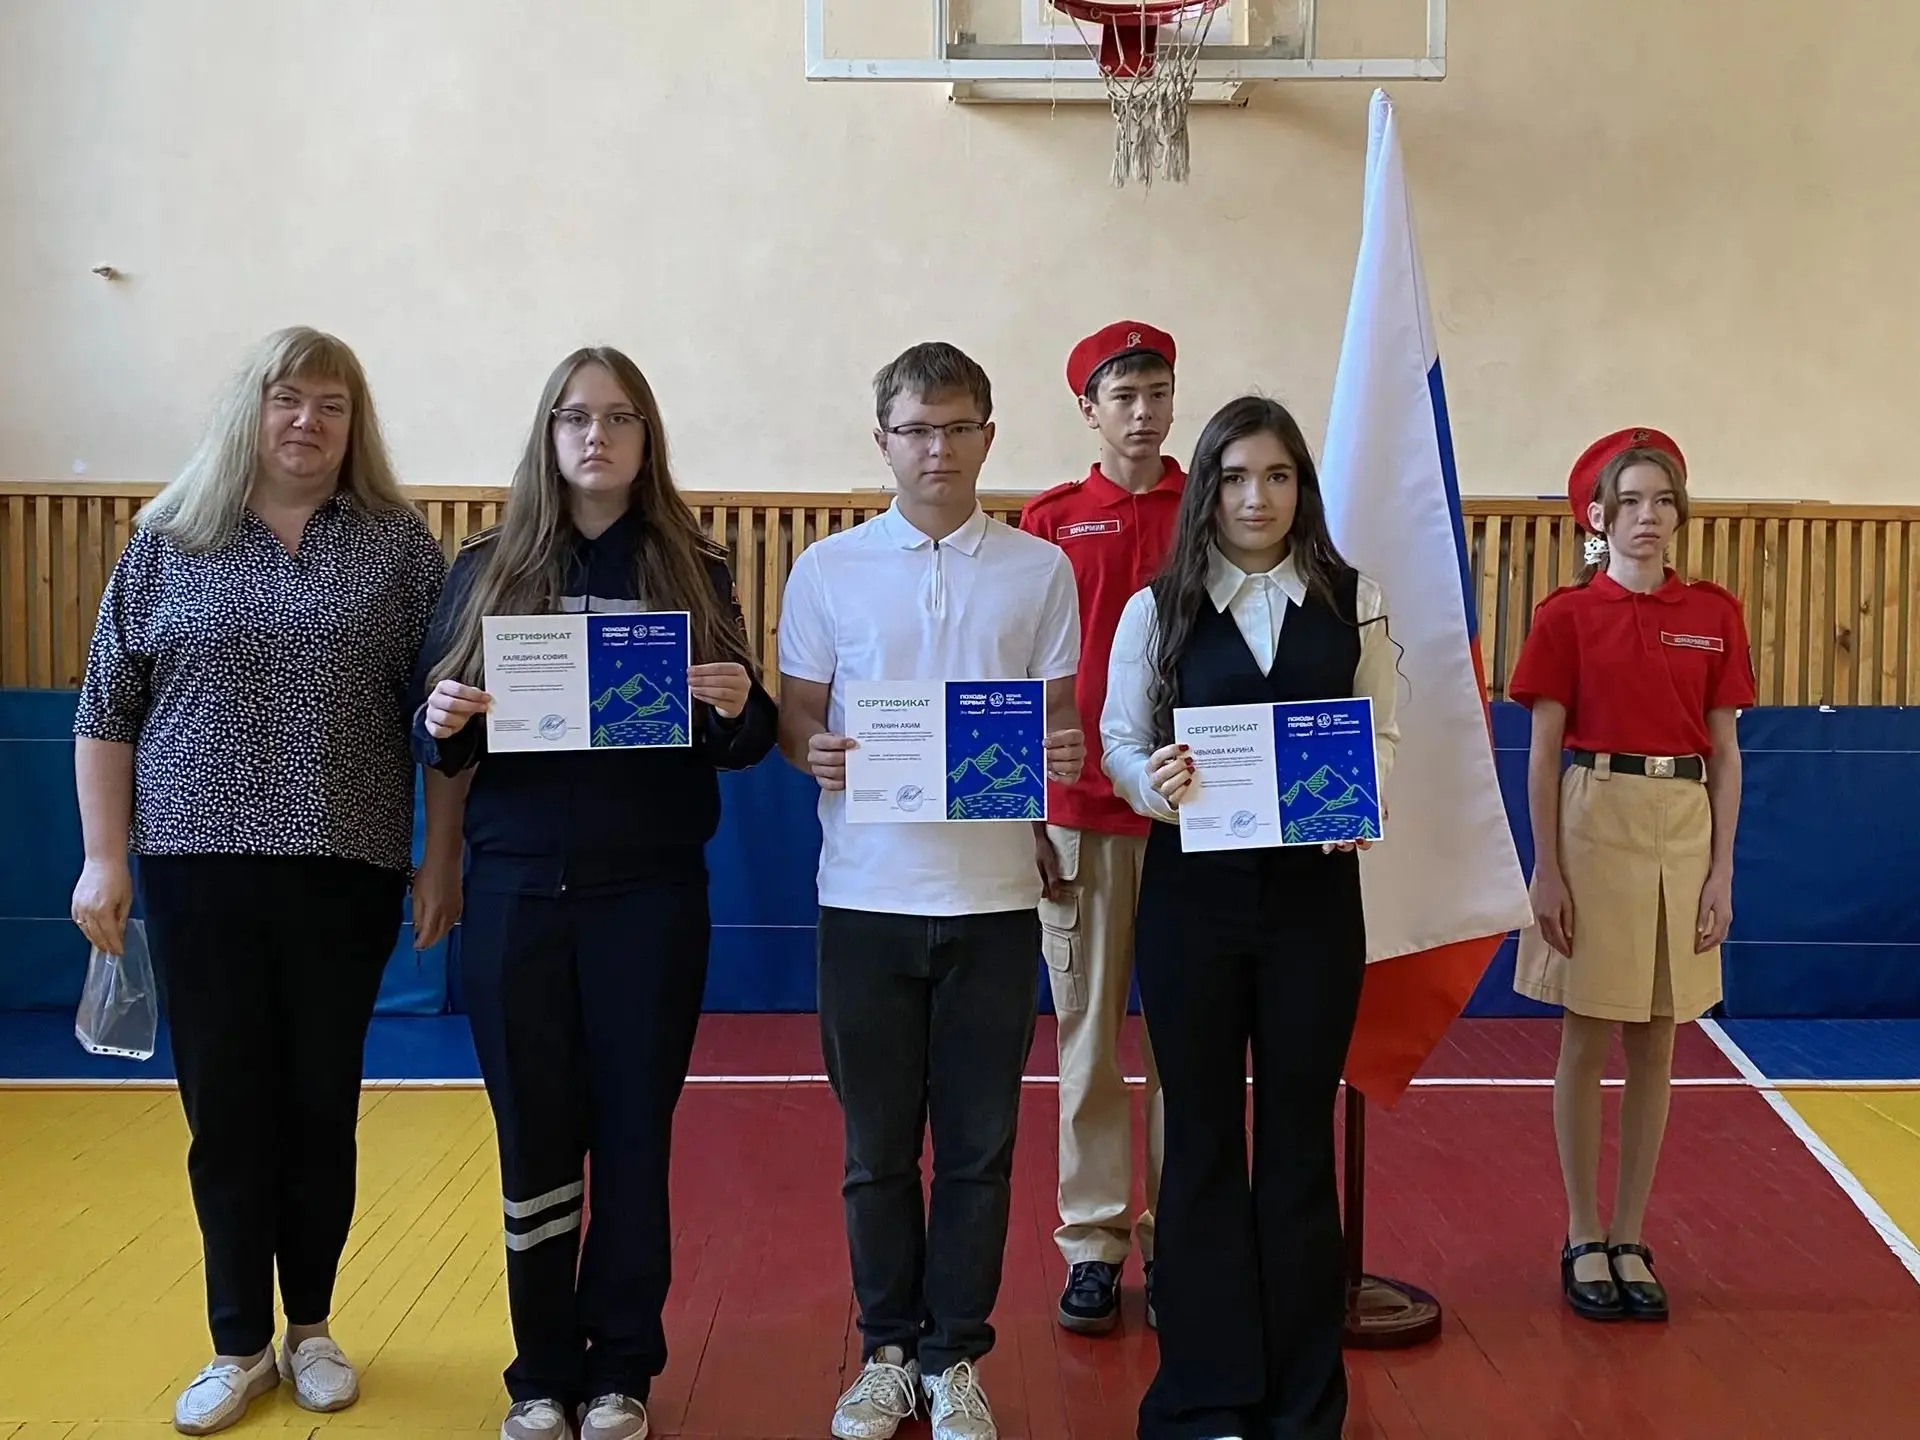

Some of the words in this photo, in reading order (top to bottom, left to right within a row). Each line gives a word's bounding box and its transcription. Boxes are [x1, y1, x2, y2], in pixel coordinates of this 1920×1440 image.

[496, 632, 573, 641] СЕРТИФИКАТ
[857, 699, 931, 707] СЕРТИФИКАТ
[1188, 724, 1259, 734] СЕРТИФИКАТ
[1226, 746, 1255, 754] КАРИНА
